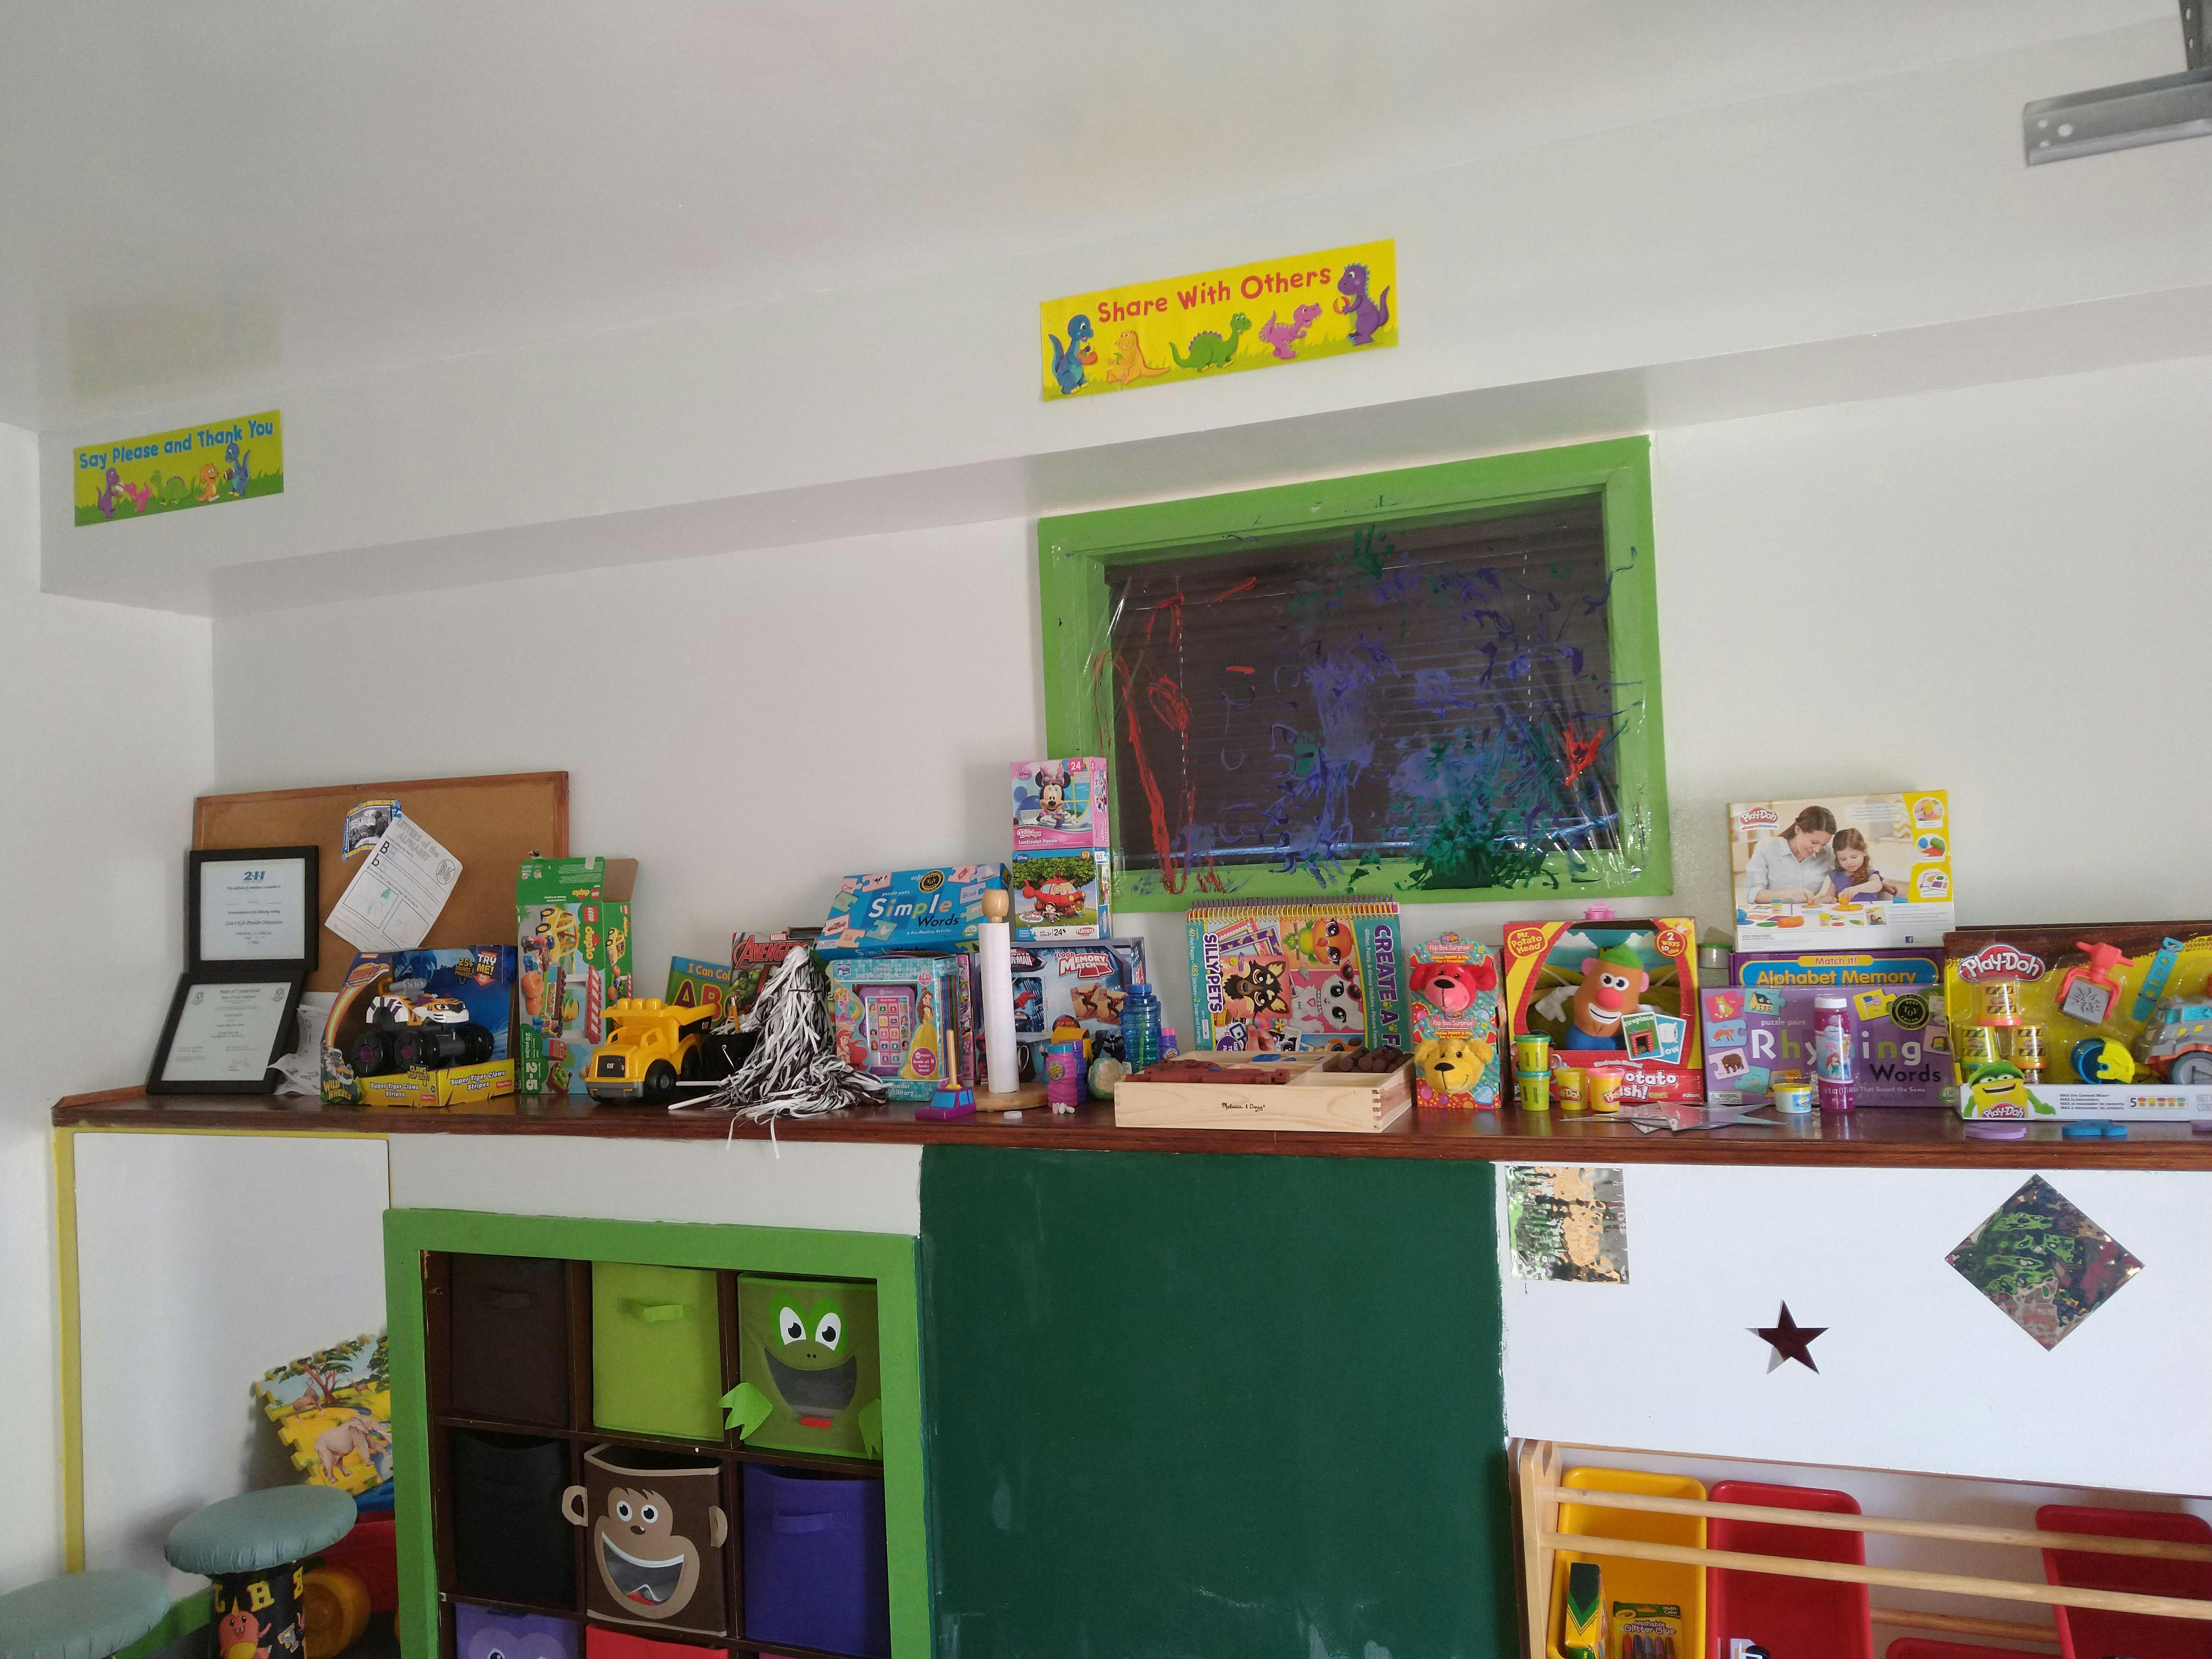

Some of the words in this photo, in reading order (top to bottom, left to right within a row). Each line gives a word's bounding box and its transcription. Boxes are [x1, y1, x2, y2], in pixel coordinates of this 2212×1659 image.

[1097, 296, 1168, 324] Share
[1177, 280, 1231, 310] With
[1240, 266, 1332, 300] Others
[80, 453, 107, 470] Say
[112, 444, 158, 464] Please
[164, 434, 192, 454] and
[197, 424, 243, 447] Thank
[248, 420, 273, 438] You
[1070, 762, 1082, 770] 24
[1741, 810, 1777, 823] Play-Doh
[396, 818, 422, 842] LETTERS
[380, 841, 389, 854] B
[396, 832, 431, 861] ALPHABET
[372, 853, 379, 866] b
[572, 889, 590, 897] duplo
[868, 893, 952, 919] Simple
[918, 913, 960, 927] Words
[1188, 927, 1194, 937] 40
[1667, 932, 1674, 940] 2
[584, 926, 595, 960] duplo
[1511, 936, 1542, 948] Potato
[1516, 943, 1540, 954] Head
[478, 953, 497, 966] TRY
[1203, 933, 1220, 973] SILLY
[458, 958, 474, 967] 25+
[1374, 925, 1397, 1001] CREATE
[1815, 957, 1843, 965] Match
[1845, 957, 1857, 965] It!
[1960, 954, 2040, 978] Play-Doh
[476, 962, 494, 975] ME!
[688, 963, 694, 974] I
[696, 966, 714, 978] Can
[1757, 970, 1836, 986] Alphabet
[1842, 970, 1916, 985] Memory
[1206, 973, 1223, 1013] PETS
[1380, 1009, 1399, 1025] A
[1902, 1006, 1919, 1016] TOY
[1624, 1016, 1654, 1028] Fireplace
[526, 1033, 531, 1041] 26
[1751, 1029, 1922, 1066] Rhying
[409, 1064, 427, 1073] CLAWS
[1869, 1063, 1941, 1082] Words
[451, 1077, 469, 1086] Super
[470, 1073, 486, 1082] Tiger
[487, 1070, 506, 1079] Claws
[526, 1062, 538, 1091] 2-5
[323, 1080, 340, 1092] WILD
[467, 1081, 490, 1091] Stripes
[328, 1088, 352, 1100] WHEELS
[1221, 1102, 1243, 1110] Melissa
[1250, 1104, 1265, 1112] Doug
[2130, 1098, 2137, 1108] 5
[1983, 1106, 2024, 1118] Play-Doh
[1623, 1624, 1655, 1634] Glitter
